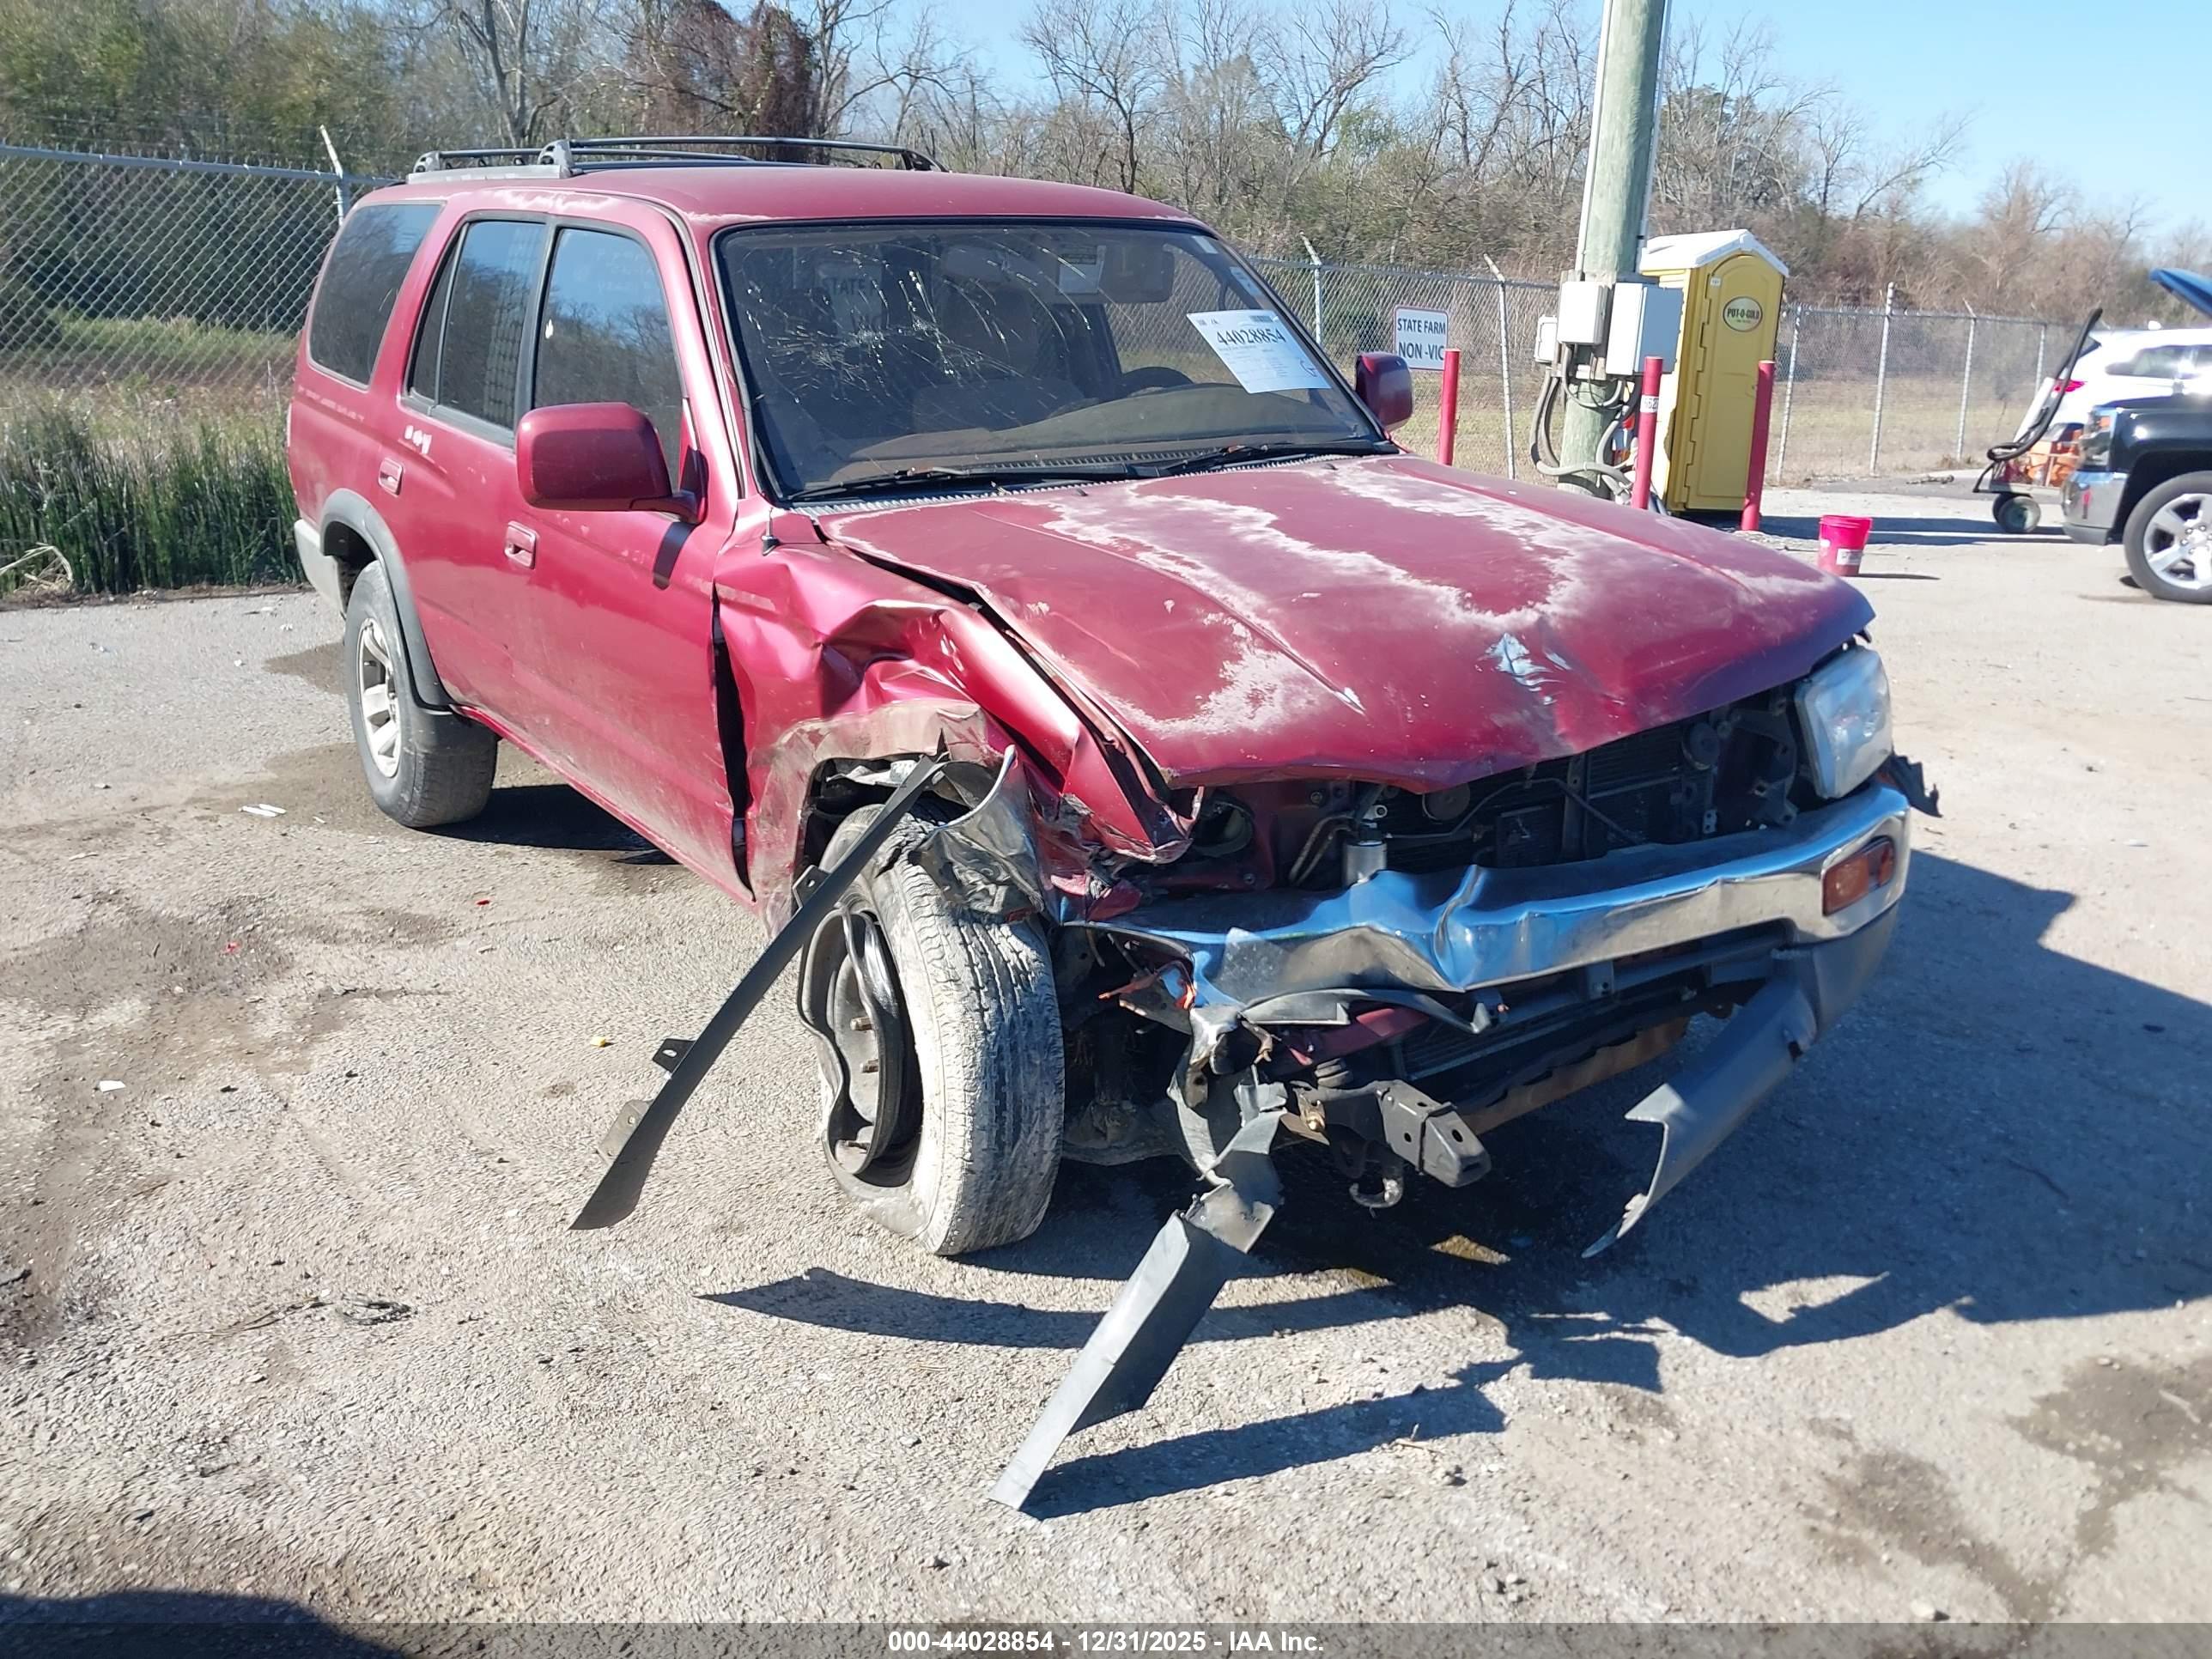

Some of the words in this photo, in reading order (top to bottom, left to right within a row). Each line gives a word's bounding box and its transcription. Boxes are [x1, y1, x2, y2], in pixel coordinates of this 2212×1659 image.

[1397, 318, 1422, 333] STATE
[1424, 320, 1446, 335] FARM
[1216, 328, 1286, 345] 44028854
[1398, 342, 1422, 359] NON
